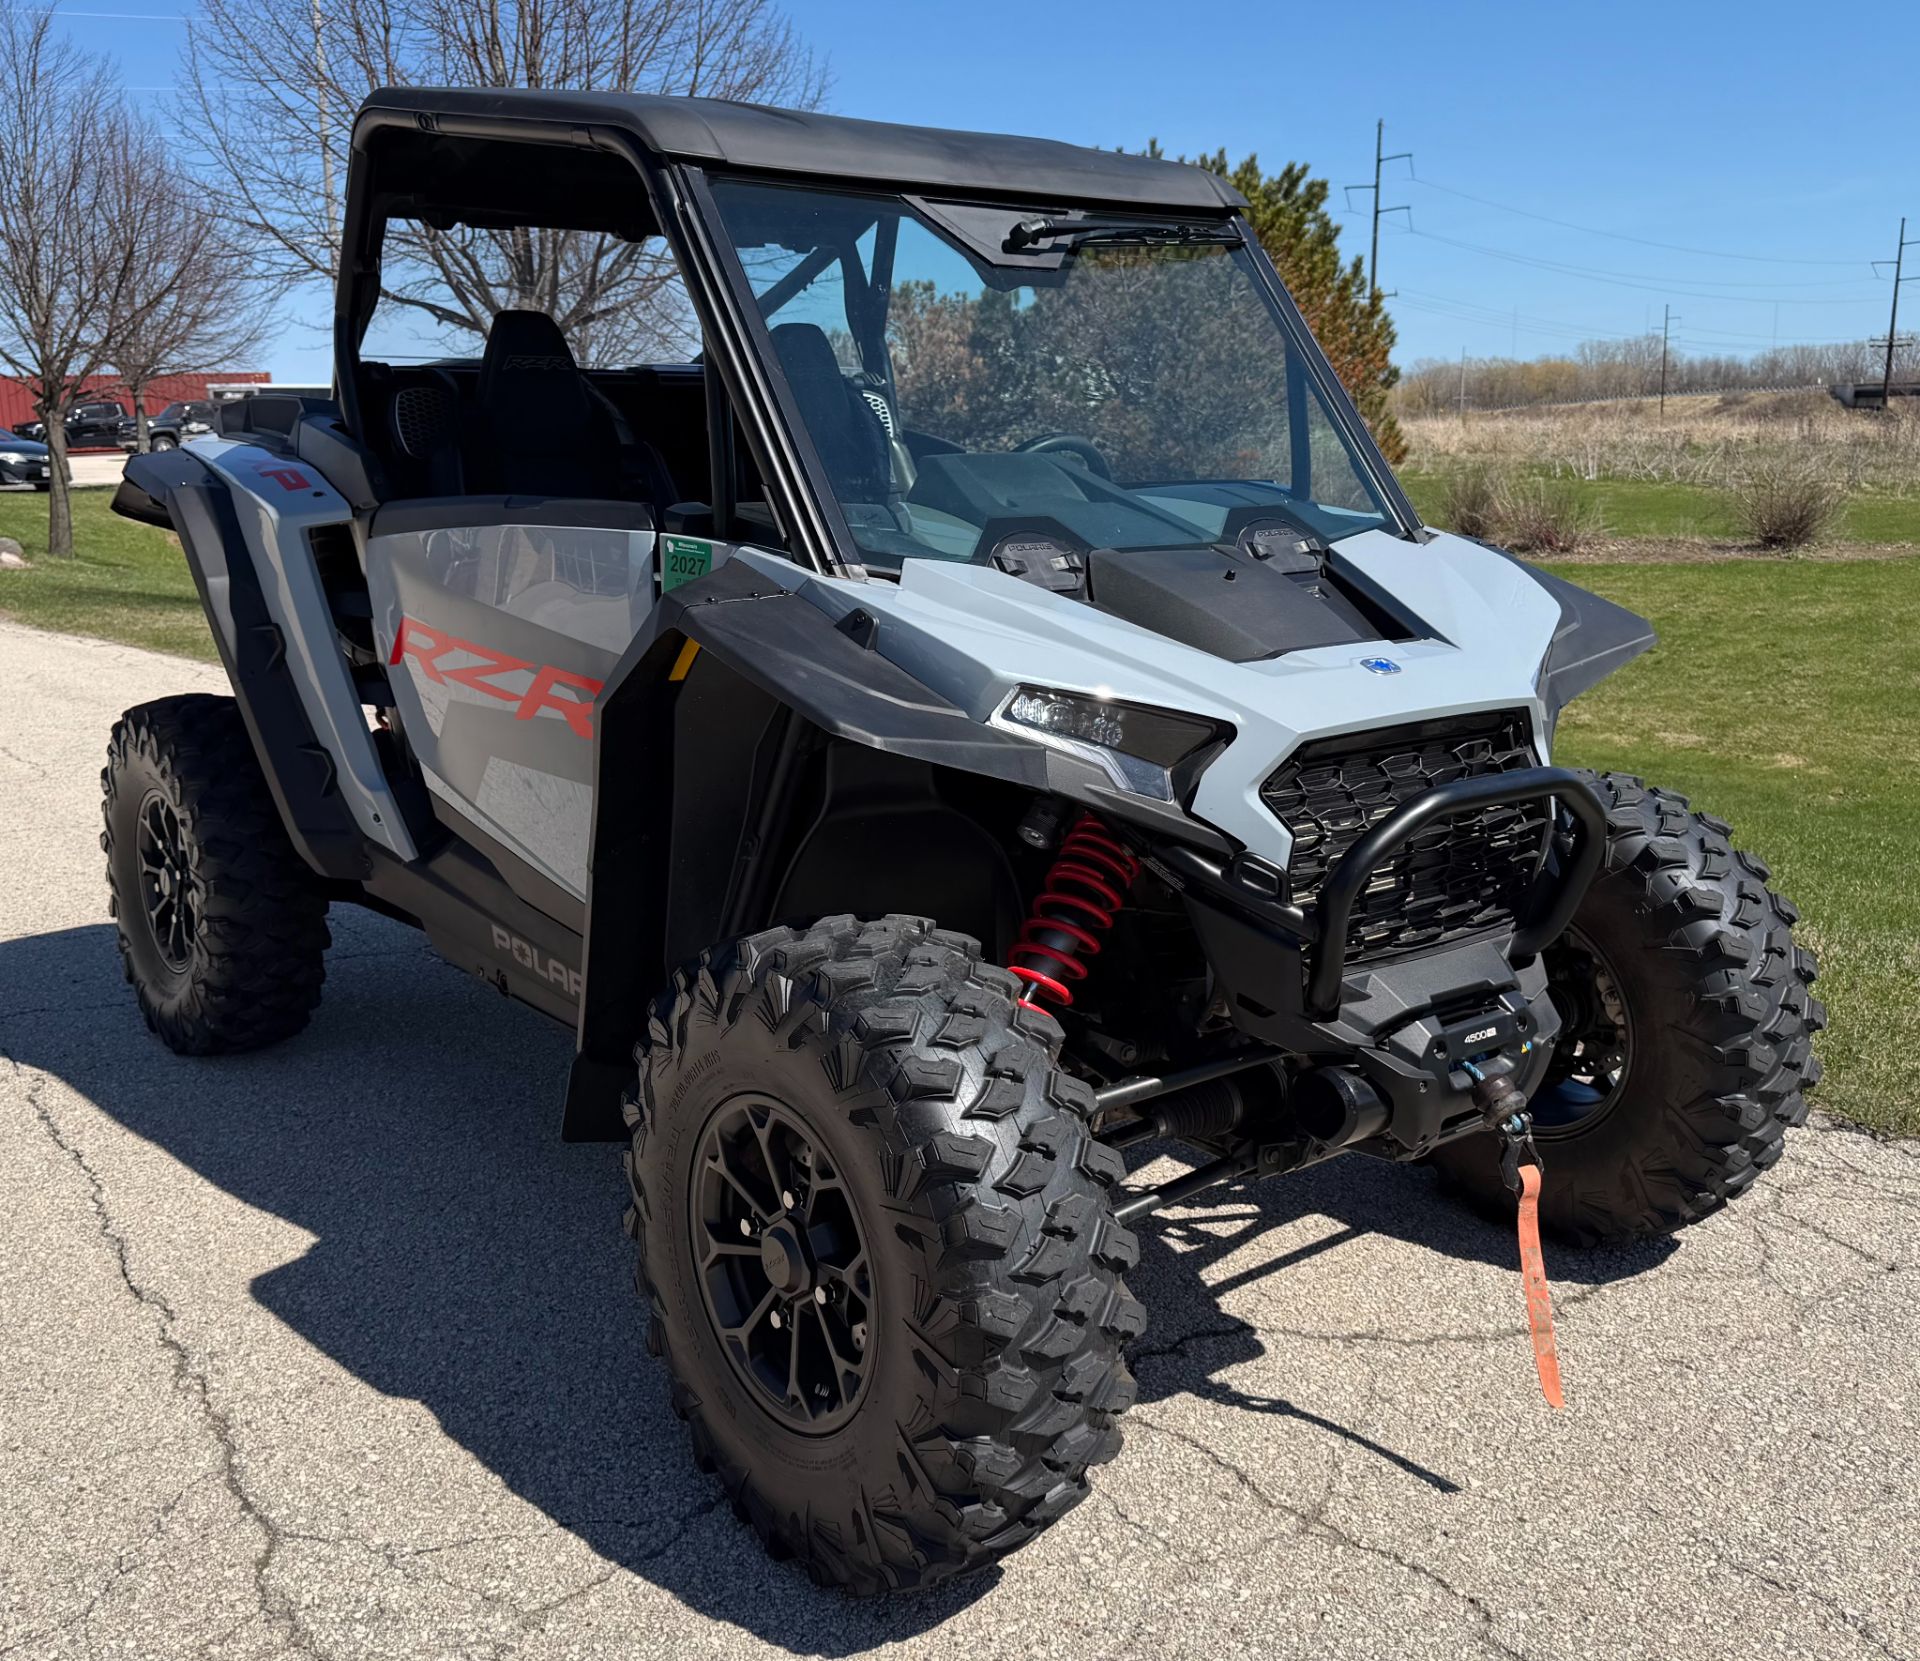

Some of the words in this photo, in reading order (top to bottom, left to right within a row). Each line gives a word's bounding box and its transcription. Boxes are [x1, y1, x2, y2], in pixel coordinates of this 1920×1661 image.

[503, 354, 571, 372] RZR
[1007, 542, 1053, 551] POLARIS
[671, 555, 705, 576] 2027
[389, 613, 605, 740] RZR
[1464, 1030, 1487, 1044] 4500
